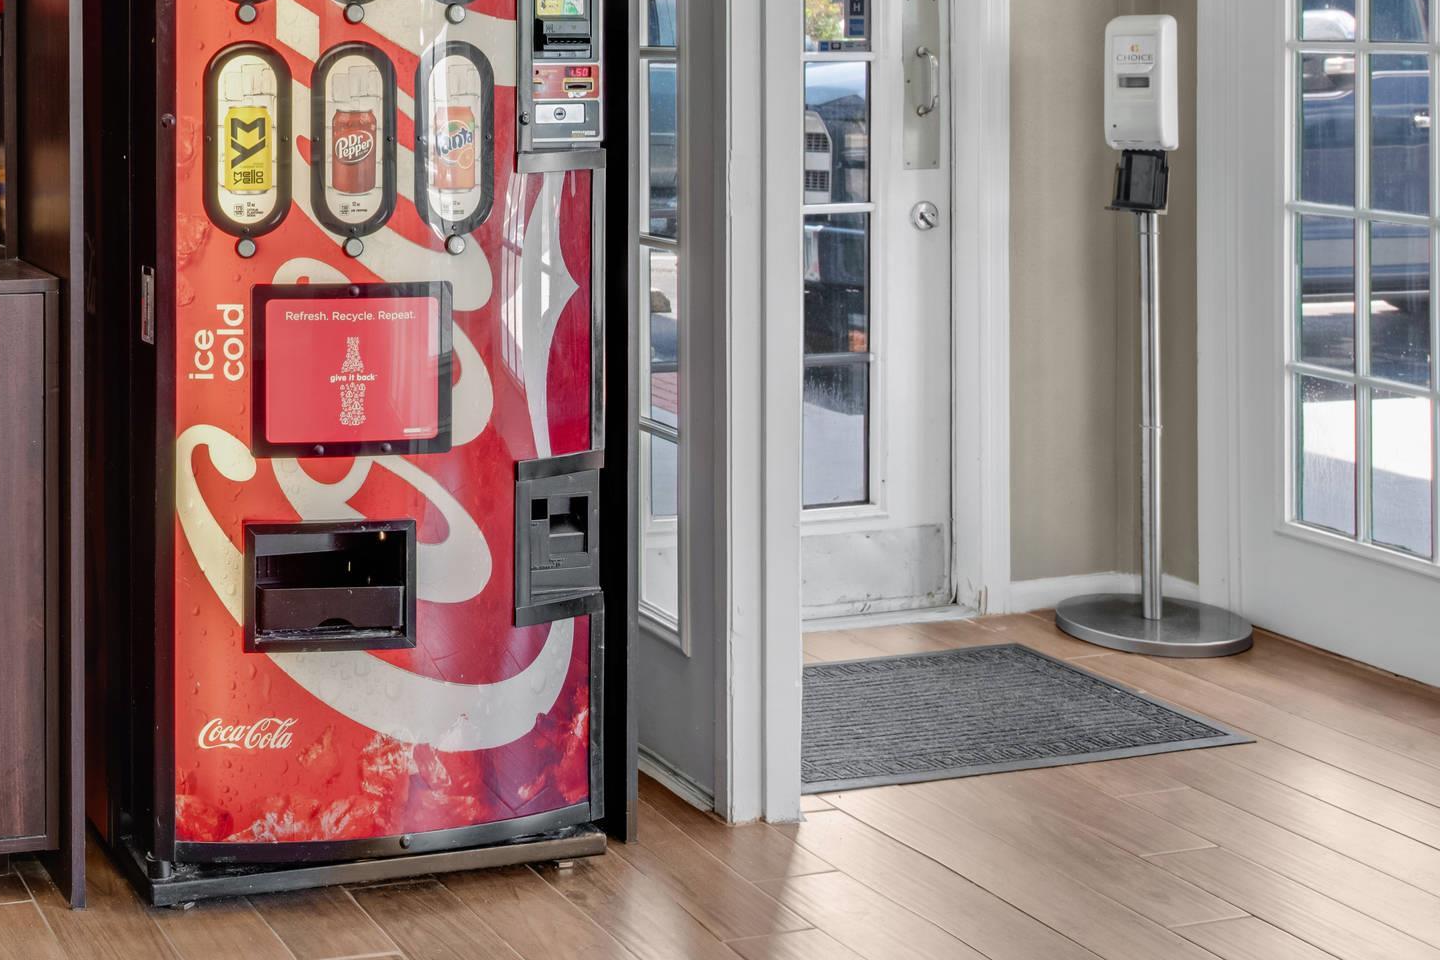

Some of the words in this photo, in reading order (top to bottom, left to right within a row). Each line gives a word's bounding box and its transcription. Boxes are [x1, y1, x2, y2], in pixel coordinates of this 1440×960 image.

[337, 137, 372, 160] Pepper
[348, 134, 364, 147] Dr
[285, 311, 329, 321] Refresh.
[332, 311, 375, 322] Recycle.
[378, 310, 416, 321] Repeat.
[216, 304, 244, 381] cold
[189, 329, 214, 380] ice
[330, 374, 347, 383] give
[349, 373, 355, 381] it
[198, 718, 299, 750] Coca-Cola
